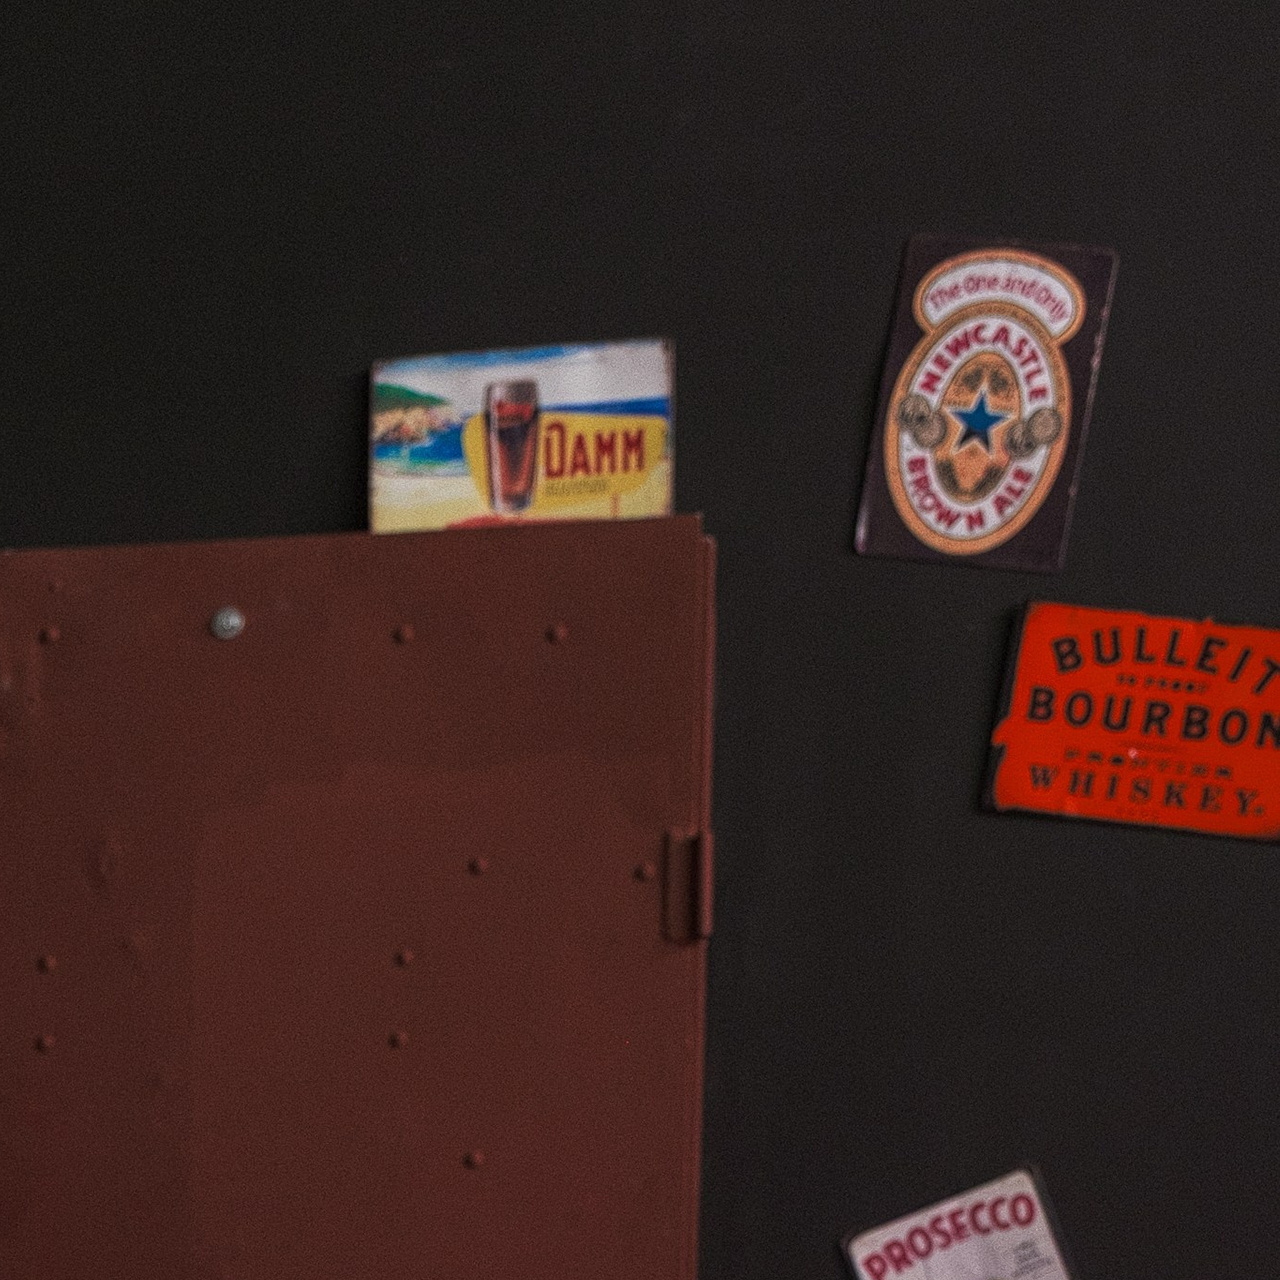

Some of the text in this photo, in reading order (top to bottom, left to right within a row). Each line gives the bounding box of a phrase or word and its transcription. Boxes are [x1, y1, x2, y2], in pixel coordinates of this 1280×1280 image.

[919, 322, 1047, 401] NEWCASTLE
[544, 420, 646, 478] DAMM
[907, 457, 1034, 533] BROWN ALE
[1051, 626, 1280, 695] BULLEIT
[1027, 686, 1280, 749] BOURBON
